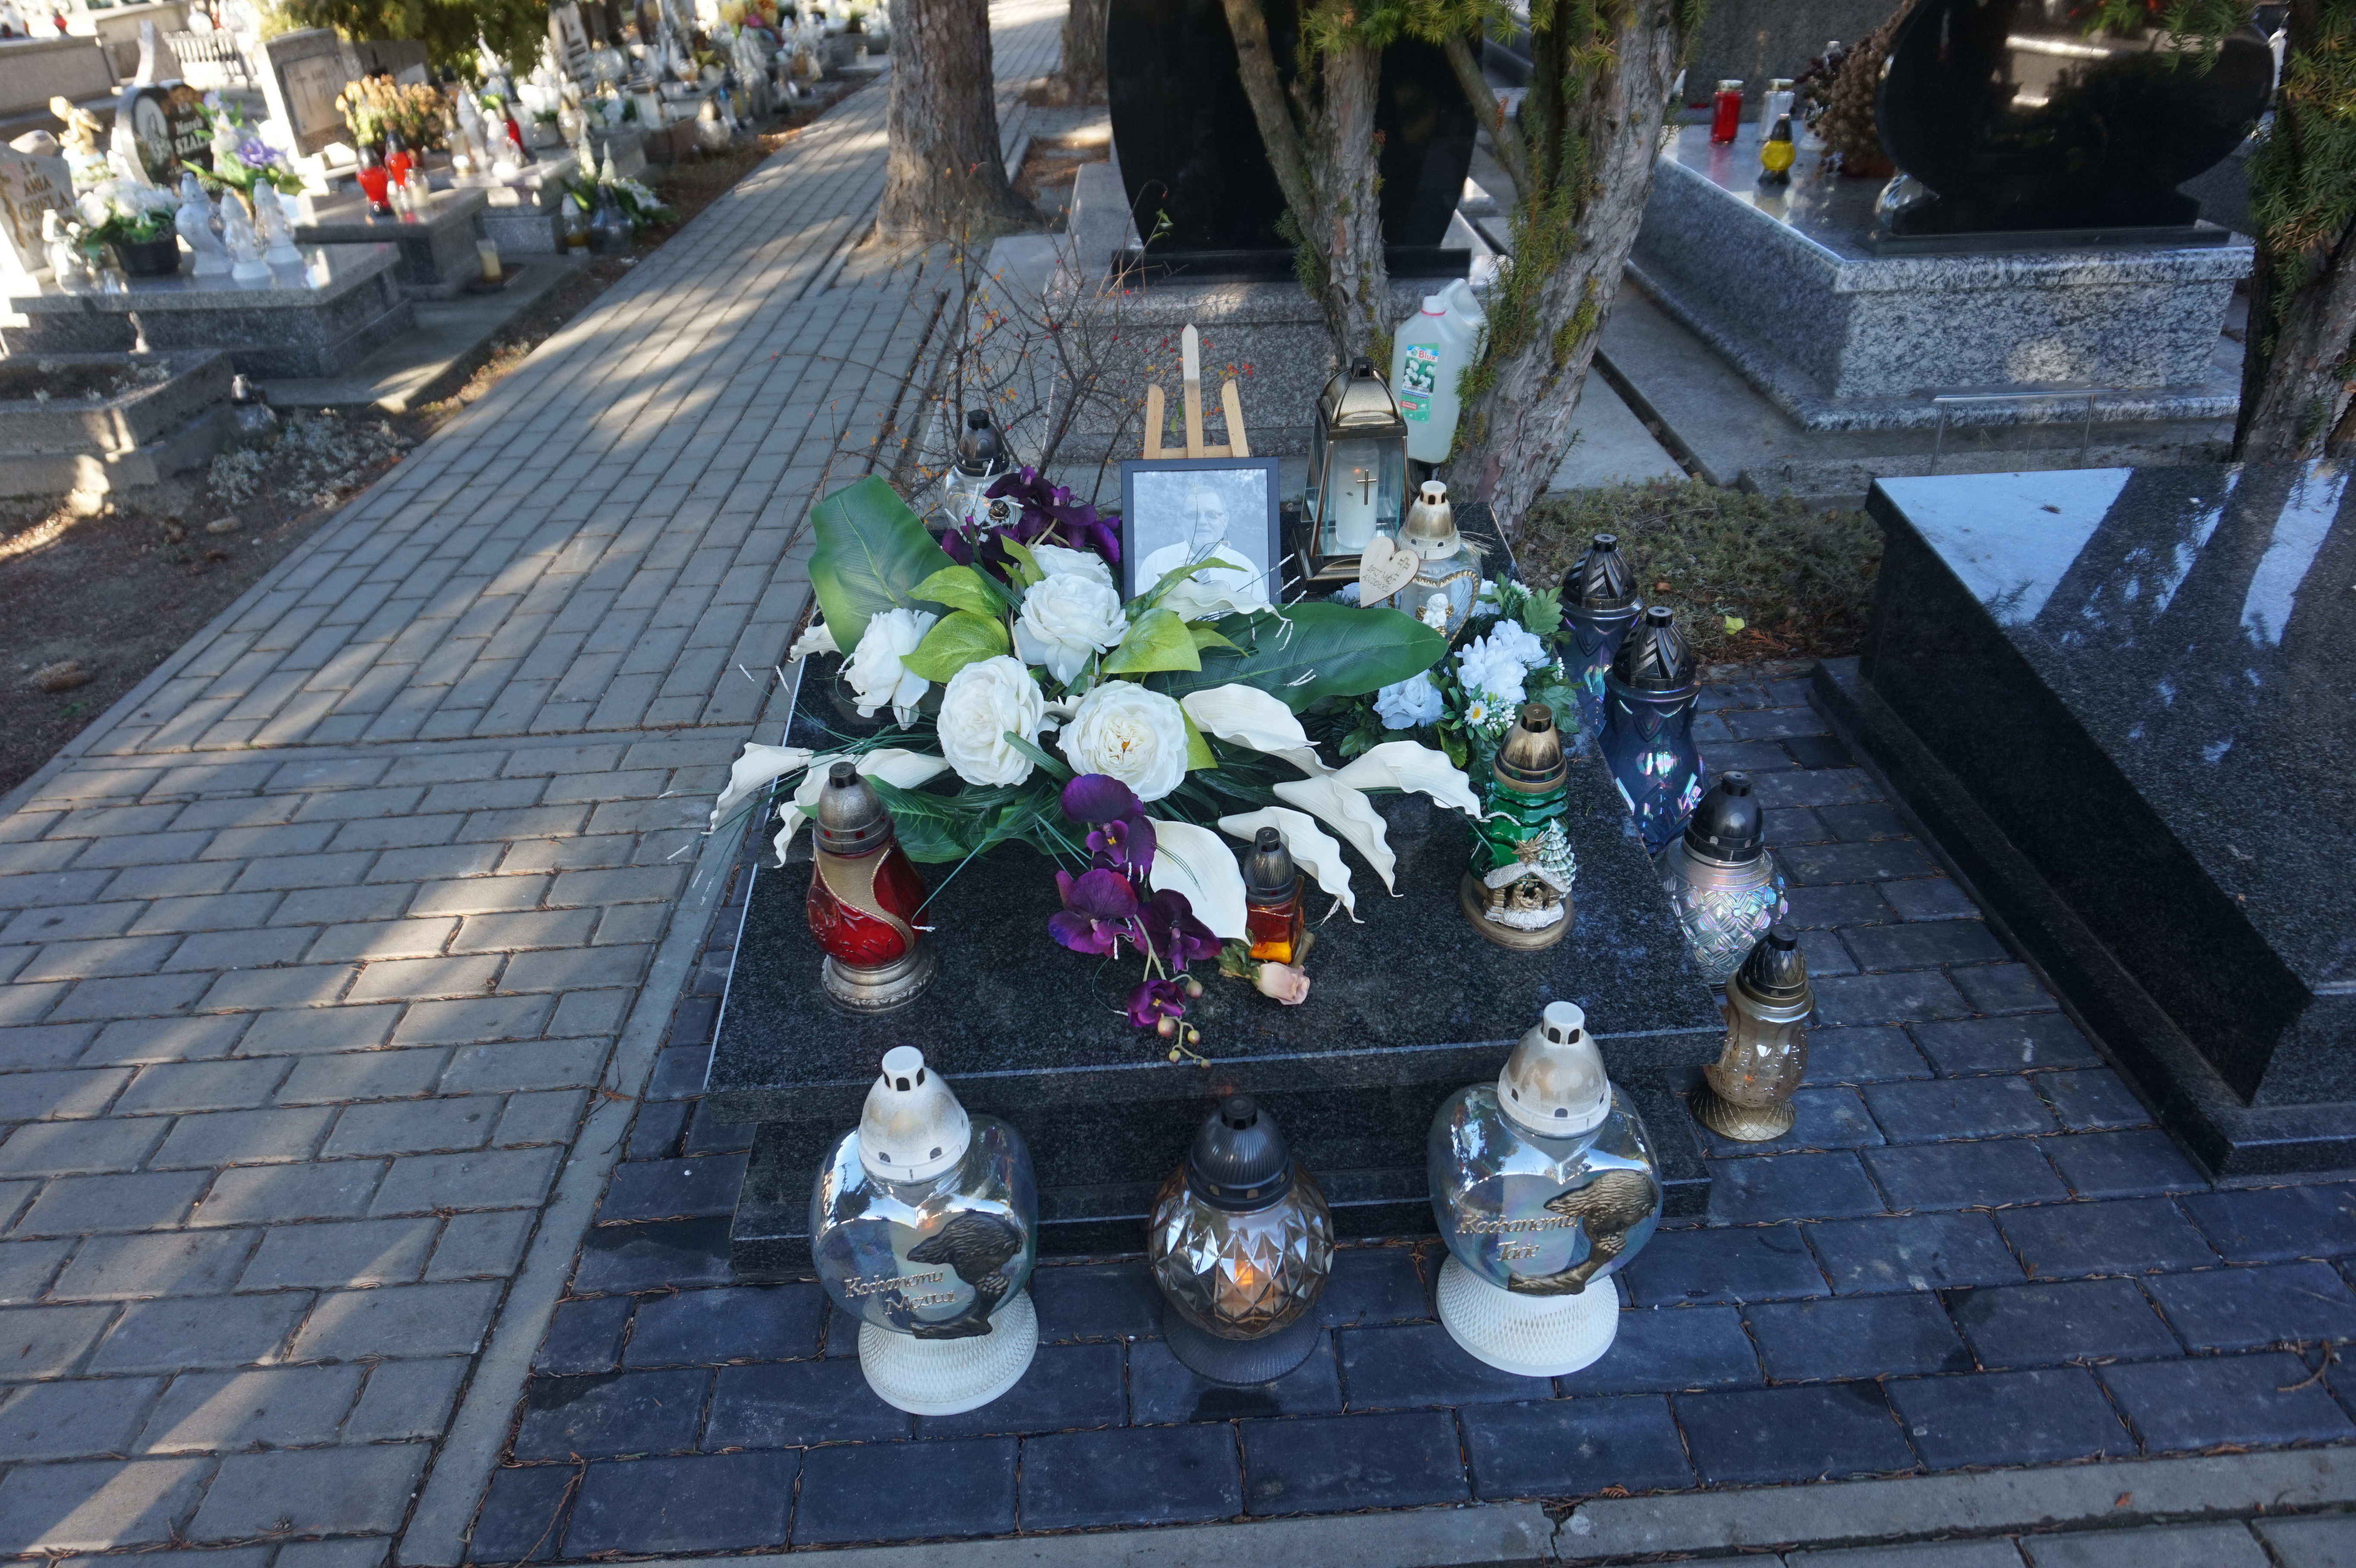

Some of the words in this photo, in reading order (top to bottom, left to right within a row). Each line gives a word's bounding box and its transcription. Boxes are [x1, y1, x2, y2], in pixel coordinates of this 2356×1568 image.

[24, 174, 53, 196] ANIA
[1418, 350, 1436, 361] Blux
[1381, 571, 1396, 585] MÓJ
[1456, 1215, 1579, 1234] Kochanemu
[1496, 1240, 1540, 1261] Tacie
[844, 1271, 944, 1298] Kochanemu
[885, 1290, 956, 1315] Mężowi
